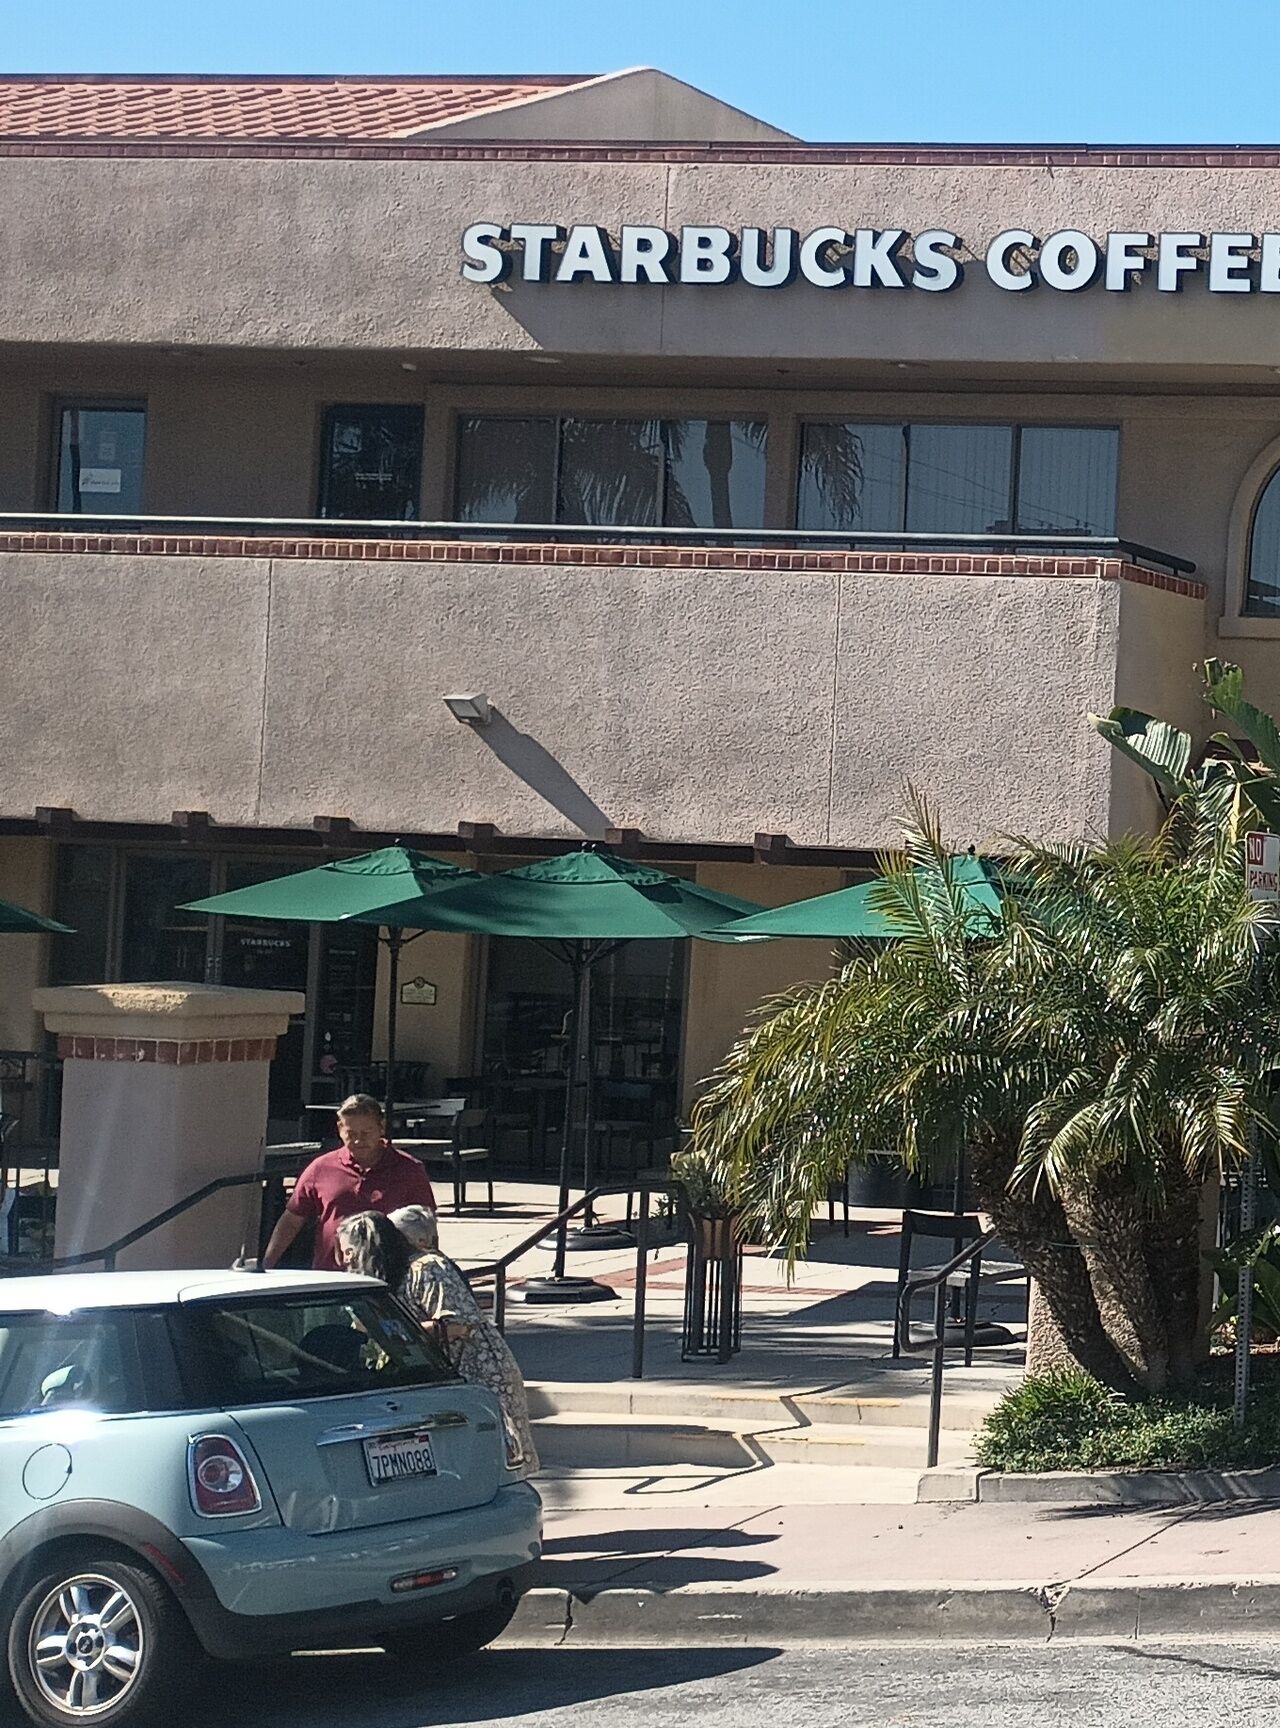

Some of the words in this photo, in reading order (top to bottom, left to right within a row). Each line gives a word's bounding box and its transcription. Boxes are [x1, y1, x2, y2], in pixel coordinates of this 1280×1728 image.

[461, 222, 962, 293] STARBUCKS
[1248, 837, 1262, 862] NO
[1249, 869, 1278, 892] PARKING
[371, 1448, 433, 1480] 7PMN088
